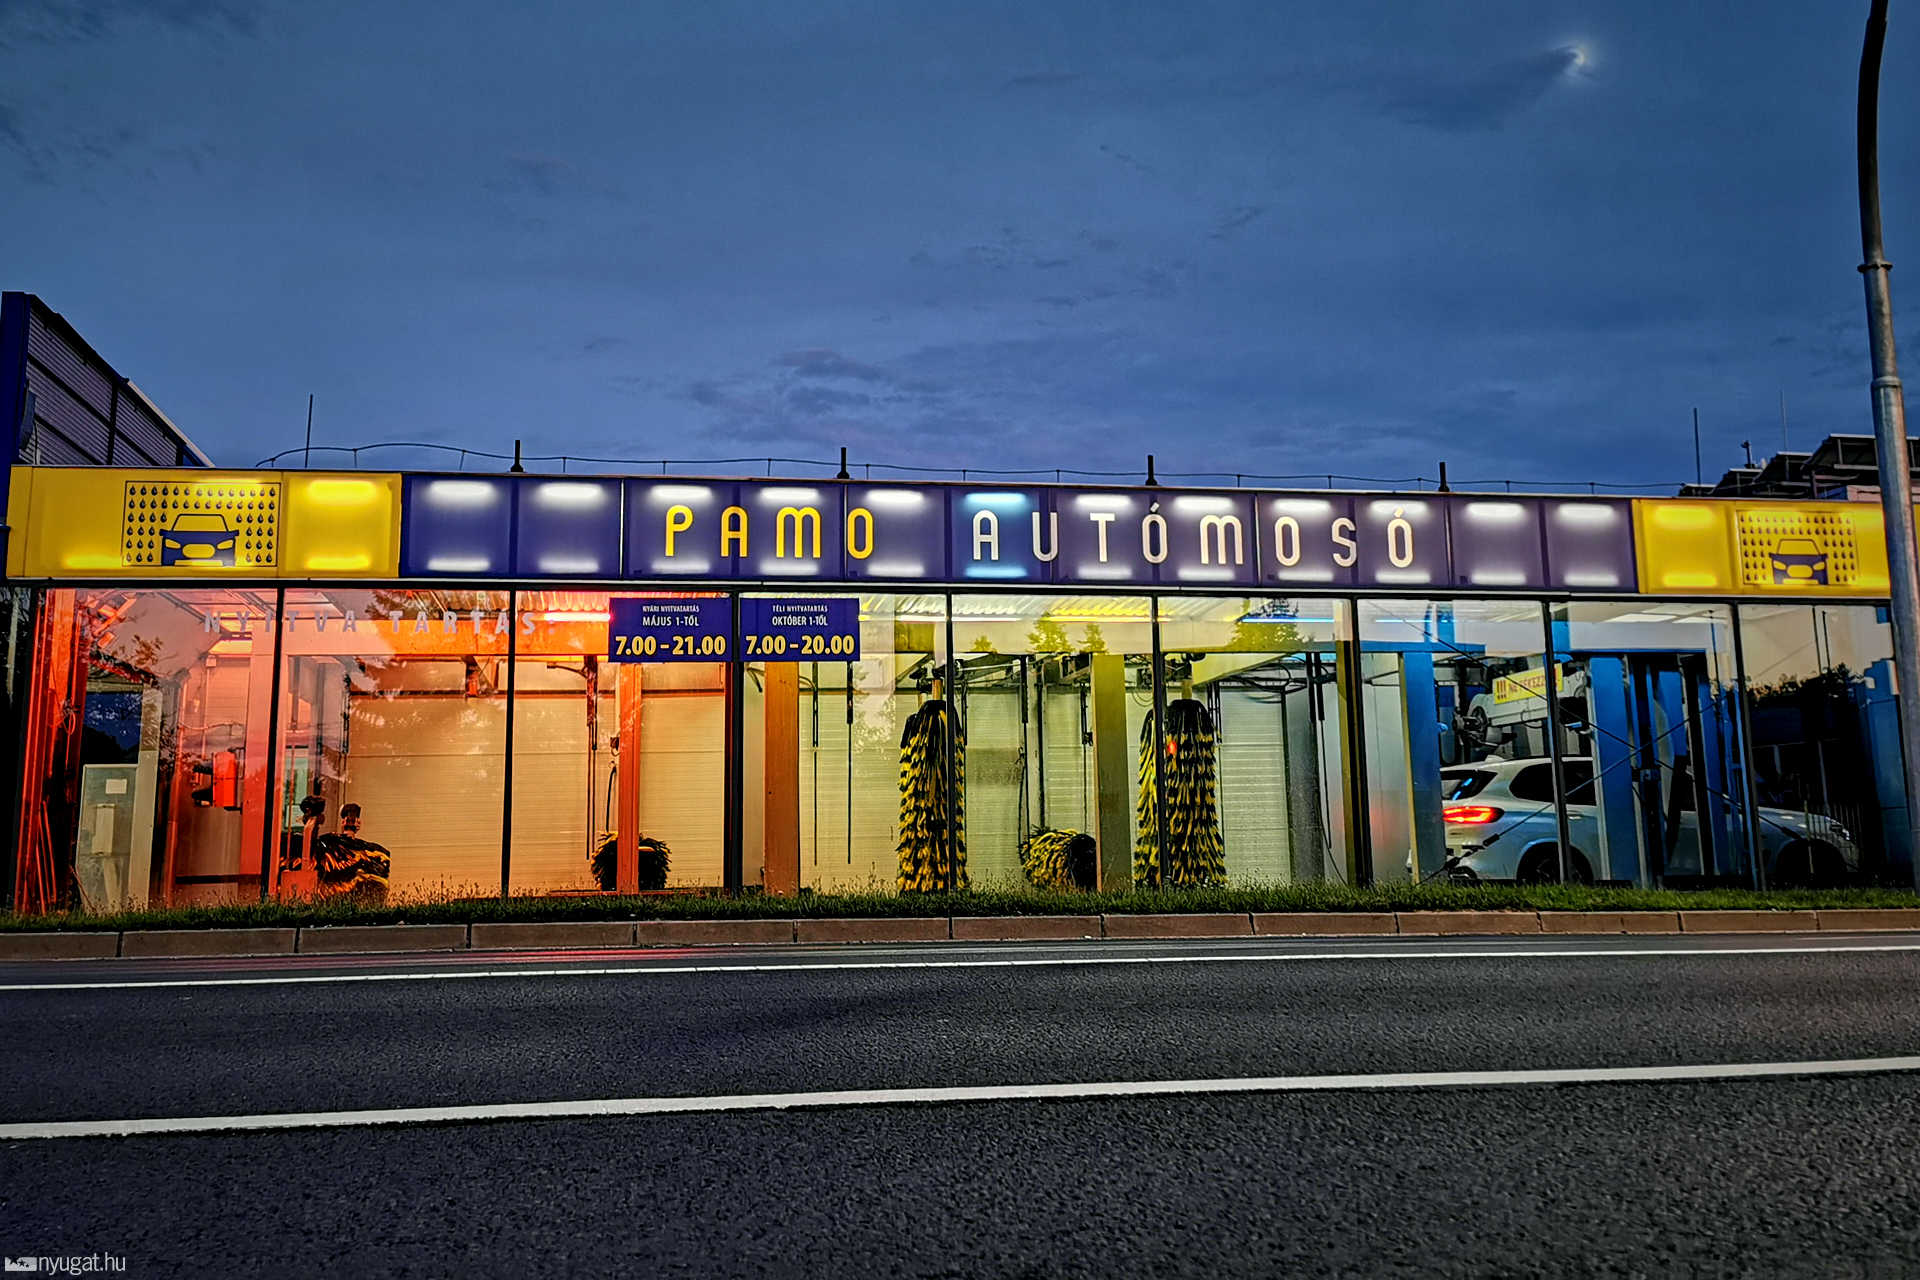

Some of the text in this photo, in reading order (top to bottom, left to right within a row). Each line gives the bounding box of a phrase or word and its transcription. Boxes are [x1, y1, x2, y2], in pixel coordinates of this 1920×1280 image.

[663, 502, 1415, 568] PAMO AUTÓMOSÓ
[642, 605, 700, 613] NYÁRI NYITVATARTÁS
[205, 610, 356, 633] NYITVA
[642, 615, 700, 626] MÁJUS 1-TŐL
[772, 614, 829, 626] OKTÓBER 1-TŐL
